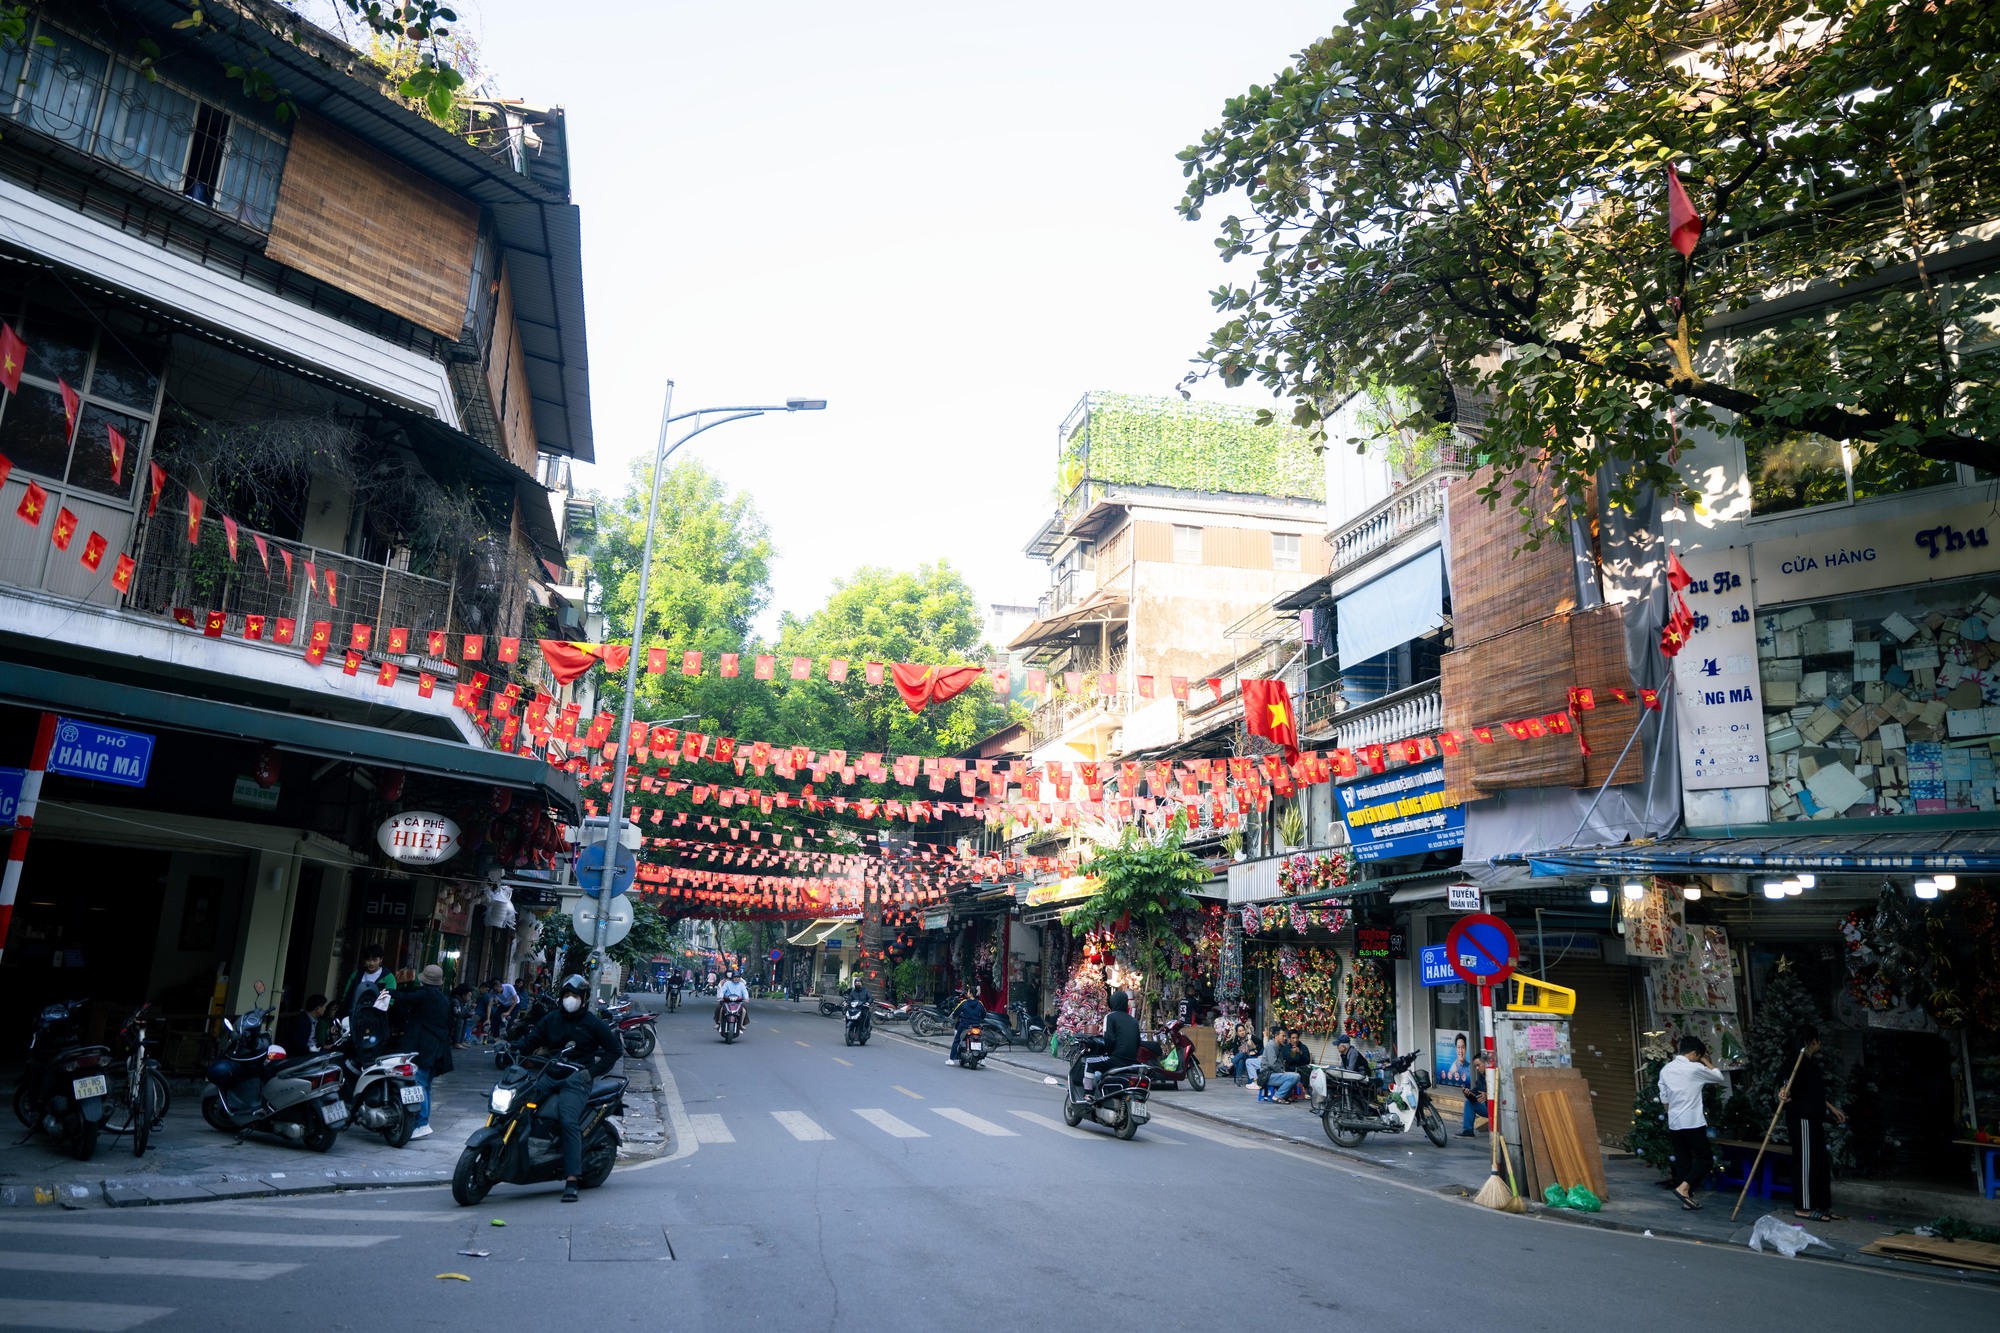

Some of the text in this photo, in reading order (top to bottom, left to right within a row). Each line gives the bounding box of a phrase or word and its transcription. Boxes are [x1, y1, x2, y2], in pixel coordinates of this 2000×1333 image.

[1914, 524, 1989, 559] Thu
[1781, 548, 1877, 574] CỬA HÀNG
[1713, 571, 1741, 595] Ha
[1729, 685, 1754, 703] MÃ
[96, 733, 129, 748] PHỐ
[57, 743, 141, 777] HÀNG MÃ
[1346, 804, 1379, 828] CHUYÊN
[1396, 796, 1422, 818] RĂNG
[1419, 790, 1443, 813] HÀM
[404, 816, 420, 827] CÀ
[393, 829, 451, 852] HIỆP
[366, 892, 407, 916] aha
[1450, 899, 1479, 909] NHÂN VIÊN
[1426, 961, 1455, 980] HÀNG
